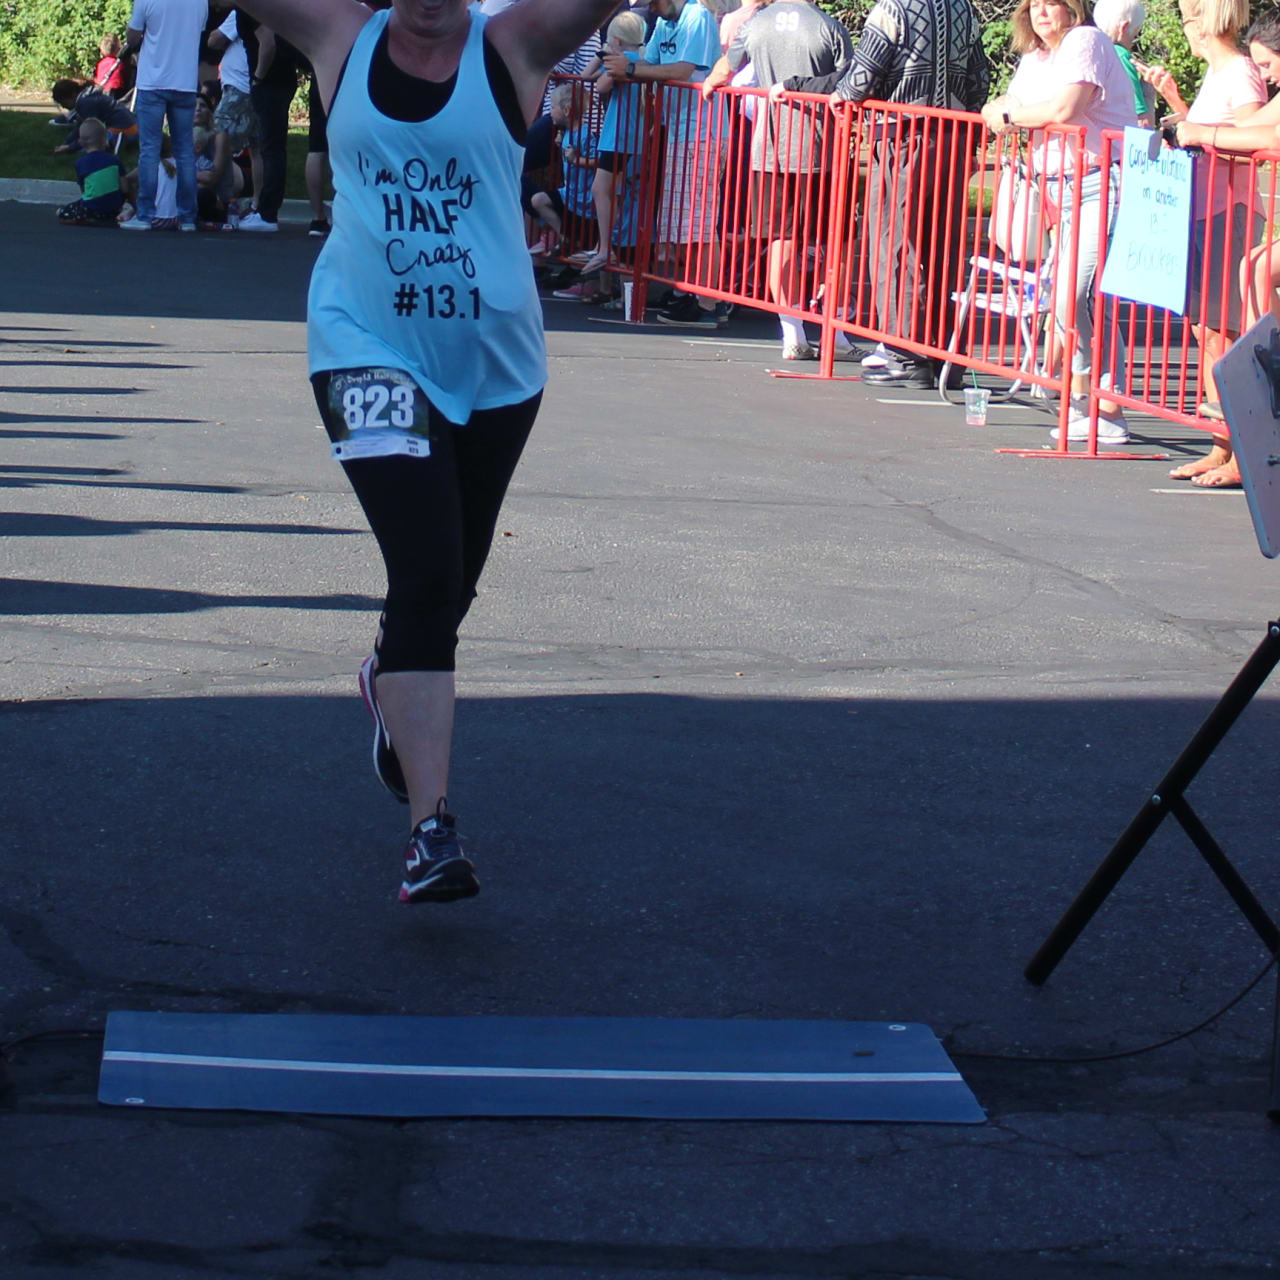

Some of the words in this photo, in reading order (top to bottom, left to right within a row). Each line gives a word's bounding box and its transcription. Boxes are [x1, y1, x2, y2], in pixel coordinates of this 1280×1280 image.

[775, 11, 800, 32] 99
[357, 151, 398, 186] I'm
[403, 157, 480, 209] Only
[382, 193, 459, 236] HALF
[386, 238, 476, 279] Crazy
[393, 283, 481, 320] #13.1
[342, 384, 414, 430] 823
